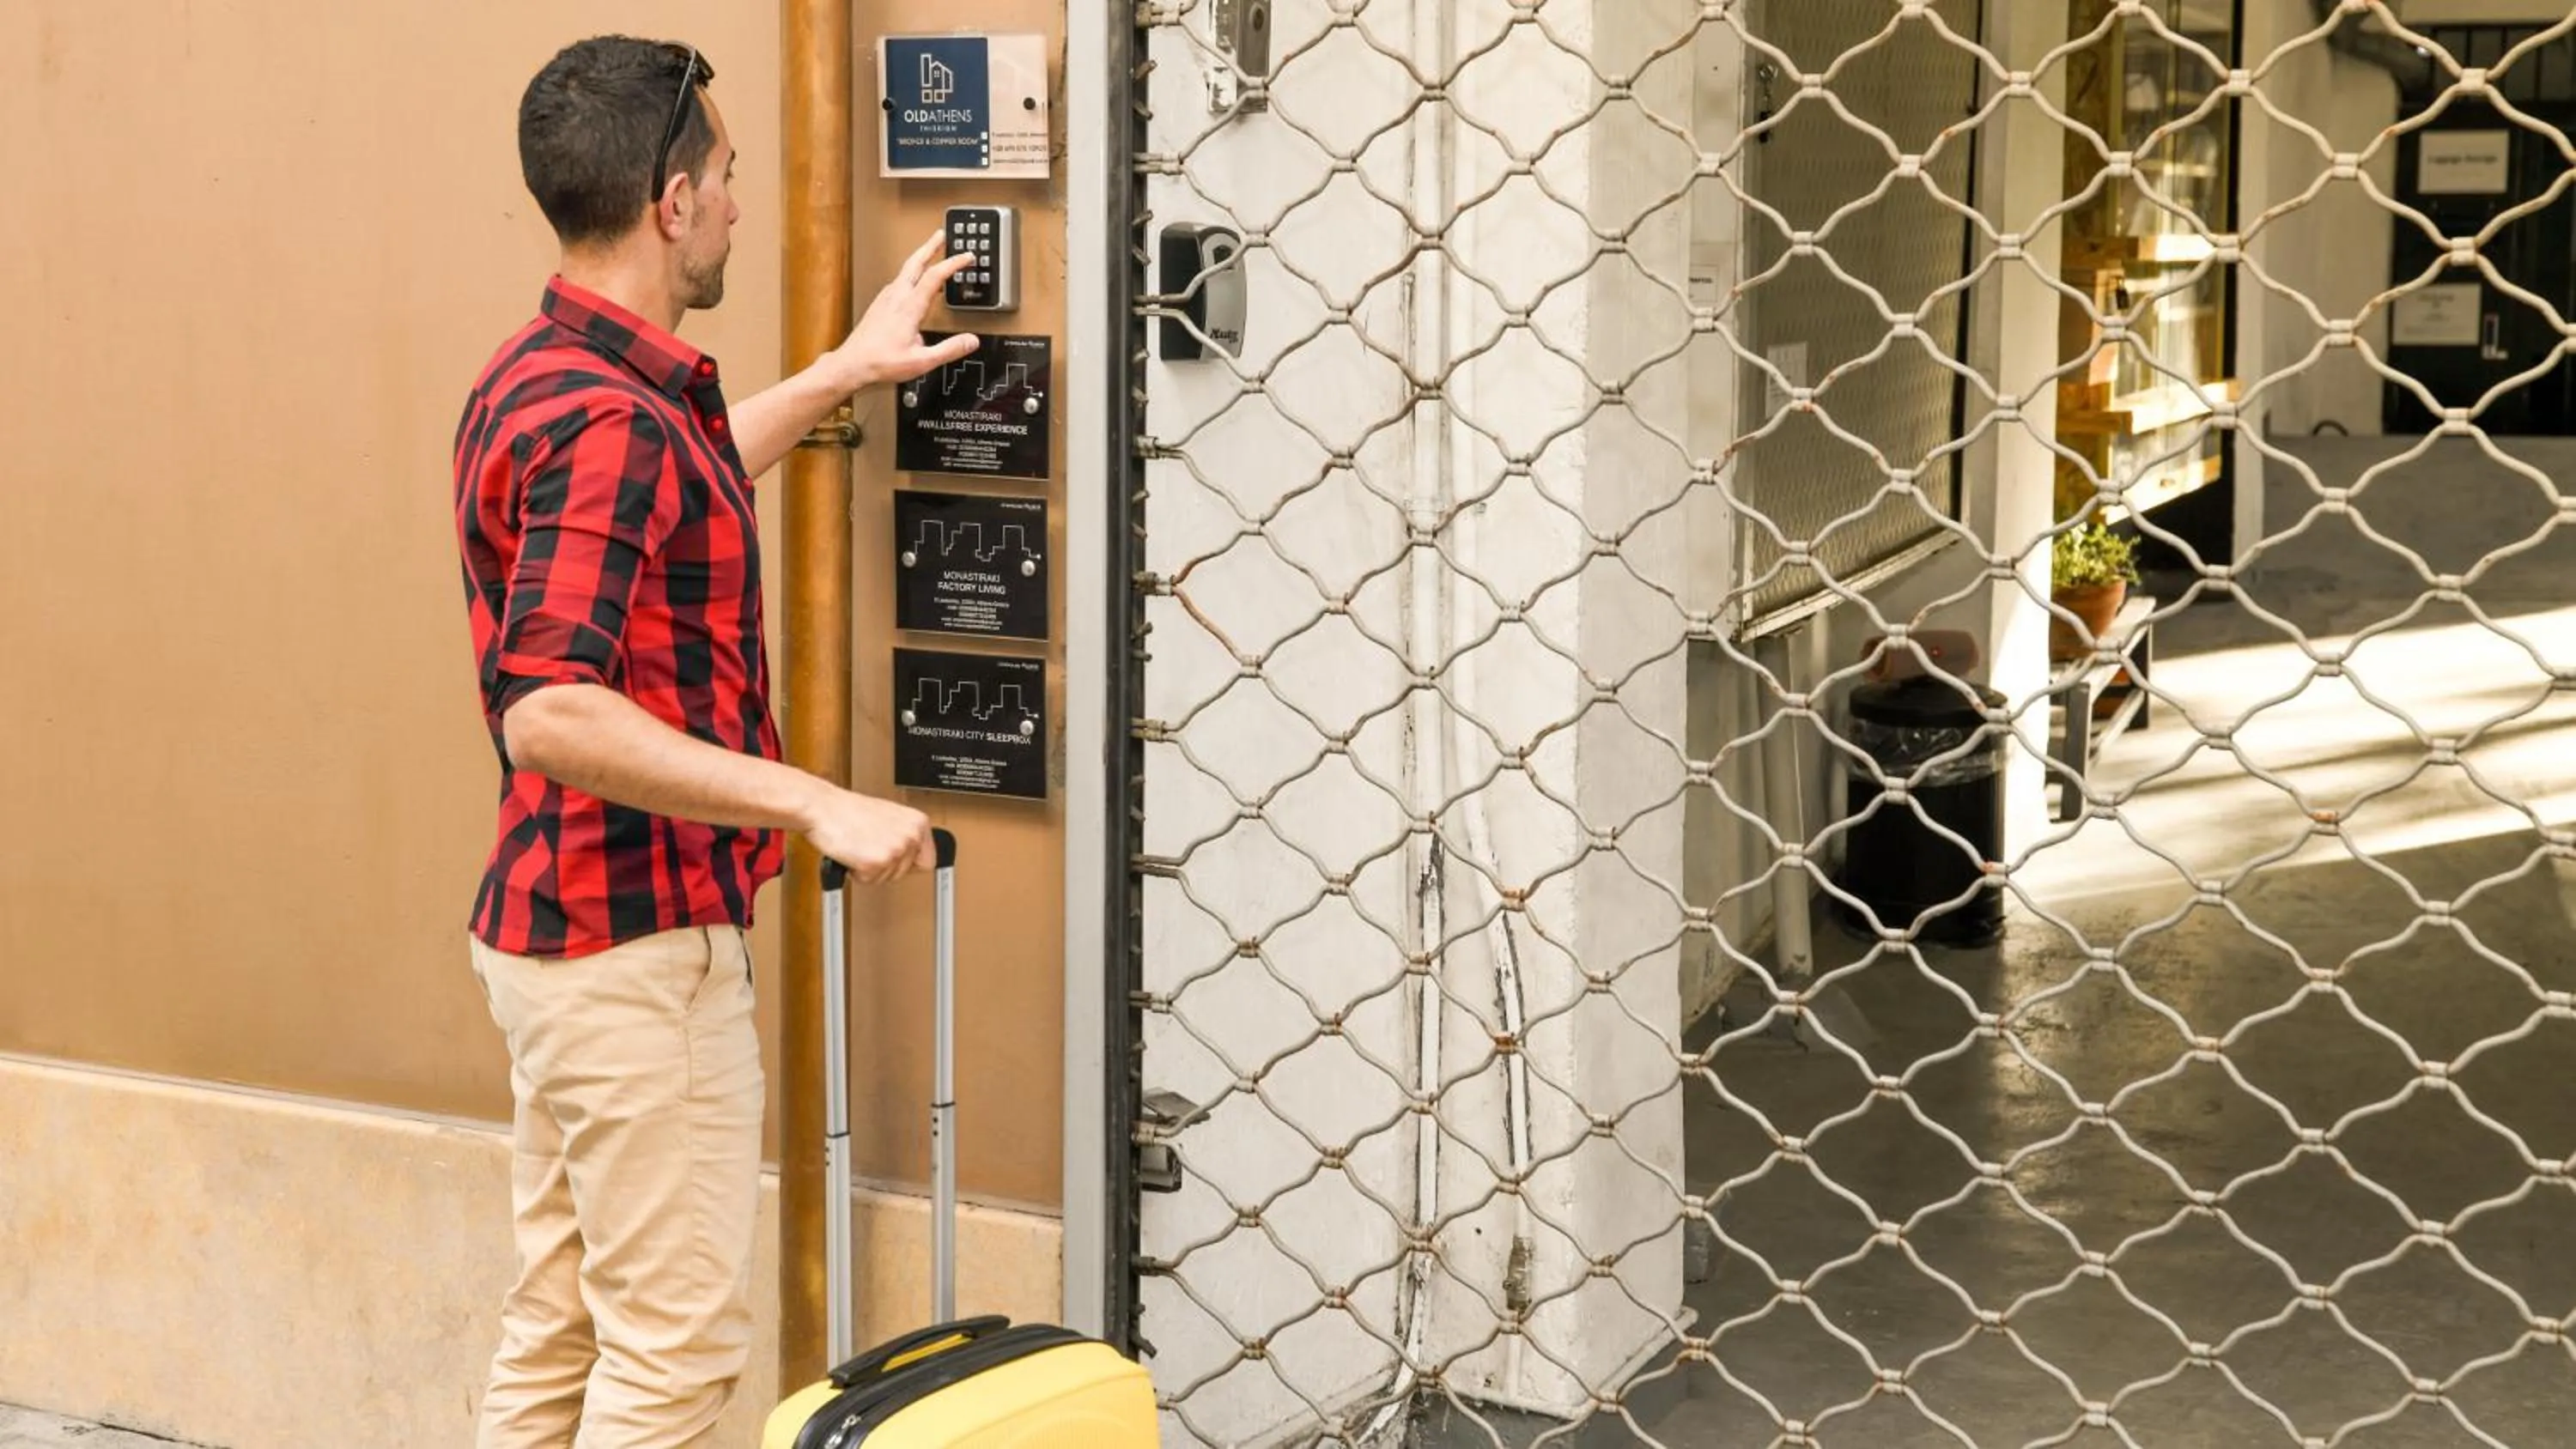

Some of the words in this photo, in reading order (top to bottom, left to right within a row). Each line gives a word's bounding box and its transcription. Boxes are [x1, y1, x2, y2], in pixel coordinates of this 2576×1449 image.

[944, 409, 1002, 421] MONASTIRAKI
[975, 423, 1029, 435] EXPERIENCE
[944, 571, 1000, 583] MONASTIRAKI
[938, 582, 976, 593] FACTORY
[978, 585, 1006, 595] LIVING
[966, 731, 985, 741] CITY
